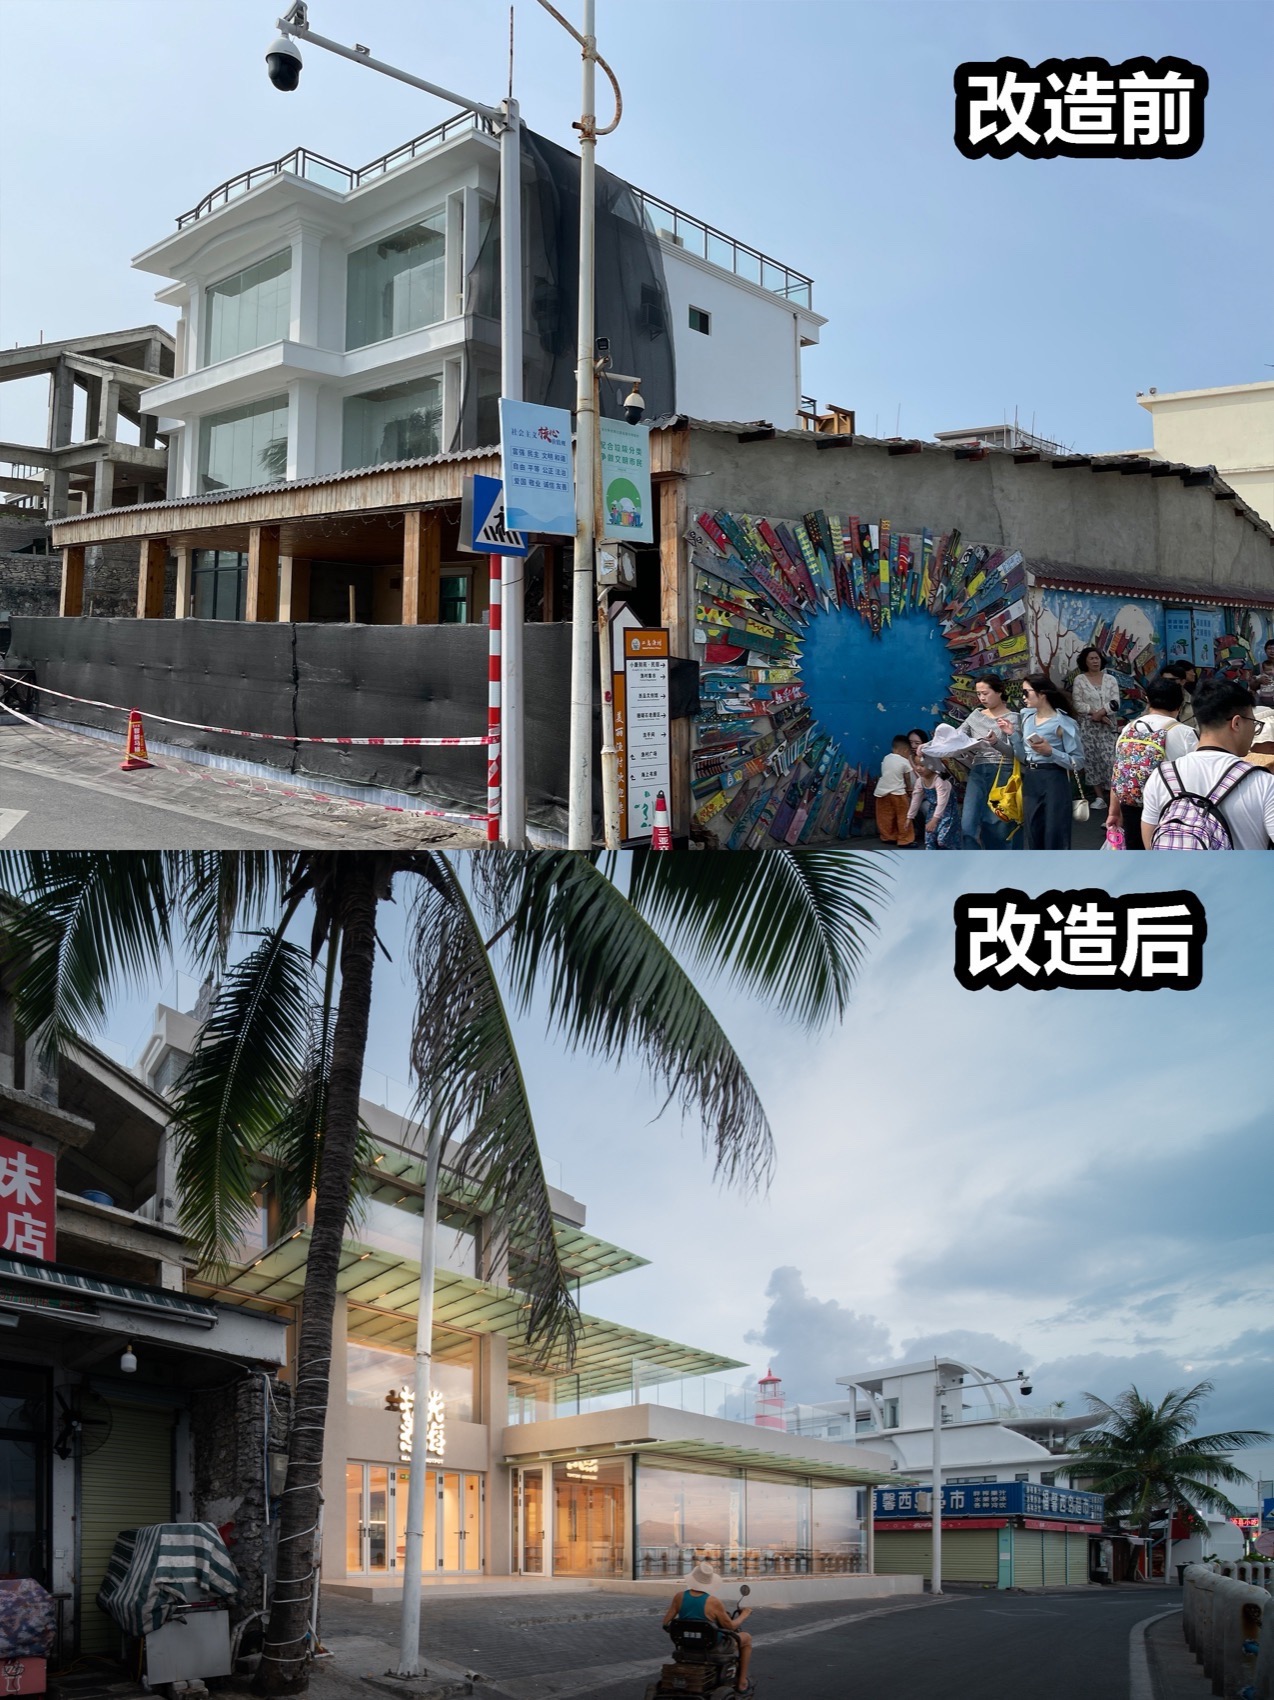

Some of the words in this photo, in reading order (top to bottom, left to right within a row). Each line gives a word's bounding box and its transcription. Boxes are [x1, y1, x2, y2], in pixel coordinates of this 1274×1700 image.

[512, 447, 525, 457] 富强
[527, 449, 540, 459] 民主
[542, 452, 554, 461] 文明
[554, 453, 566, 462] 和谐
[513, 462, 526, 471] 自由
[527, 464, 540, 473] 平等
[542, 466, 554, 475] 公正
[555, 468, 567, 477] 法治
[513, 477, 527, 486] 爱国
[528, 479, 541, 488] 敬业
[543, 480, 555, 489] 诚信
[555, 482, 567, 491] 友善
[2, 1211, 47, 1259] 店
[873, 1490, 965, 1511] 馨西市
[1042, 1489, 1089, 1515] 福馨西岛超市
